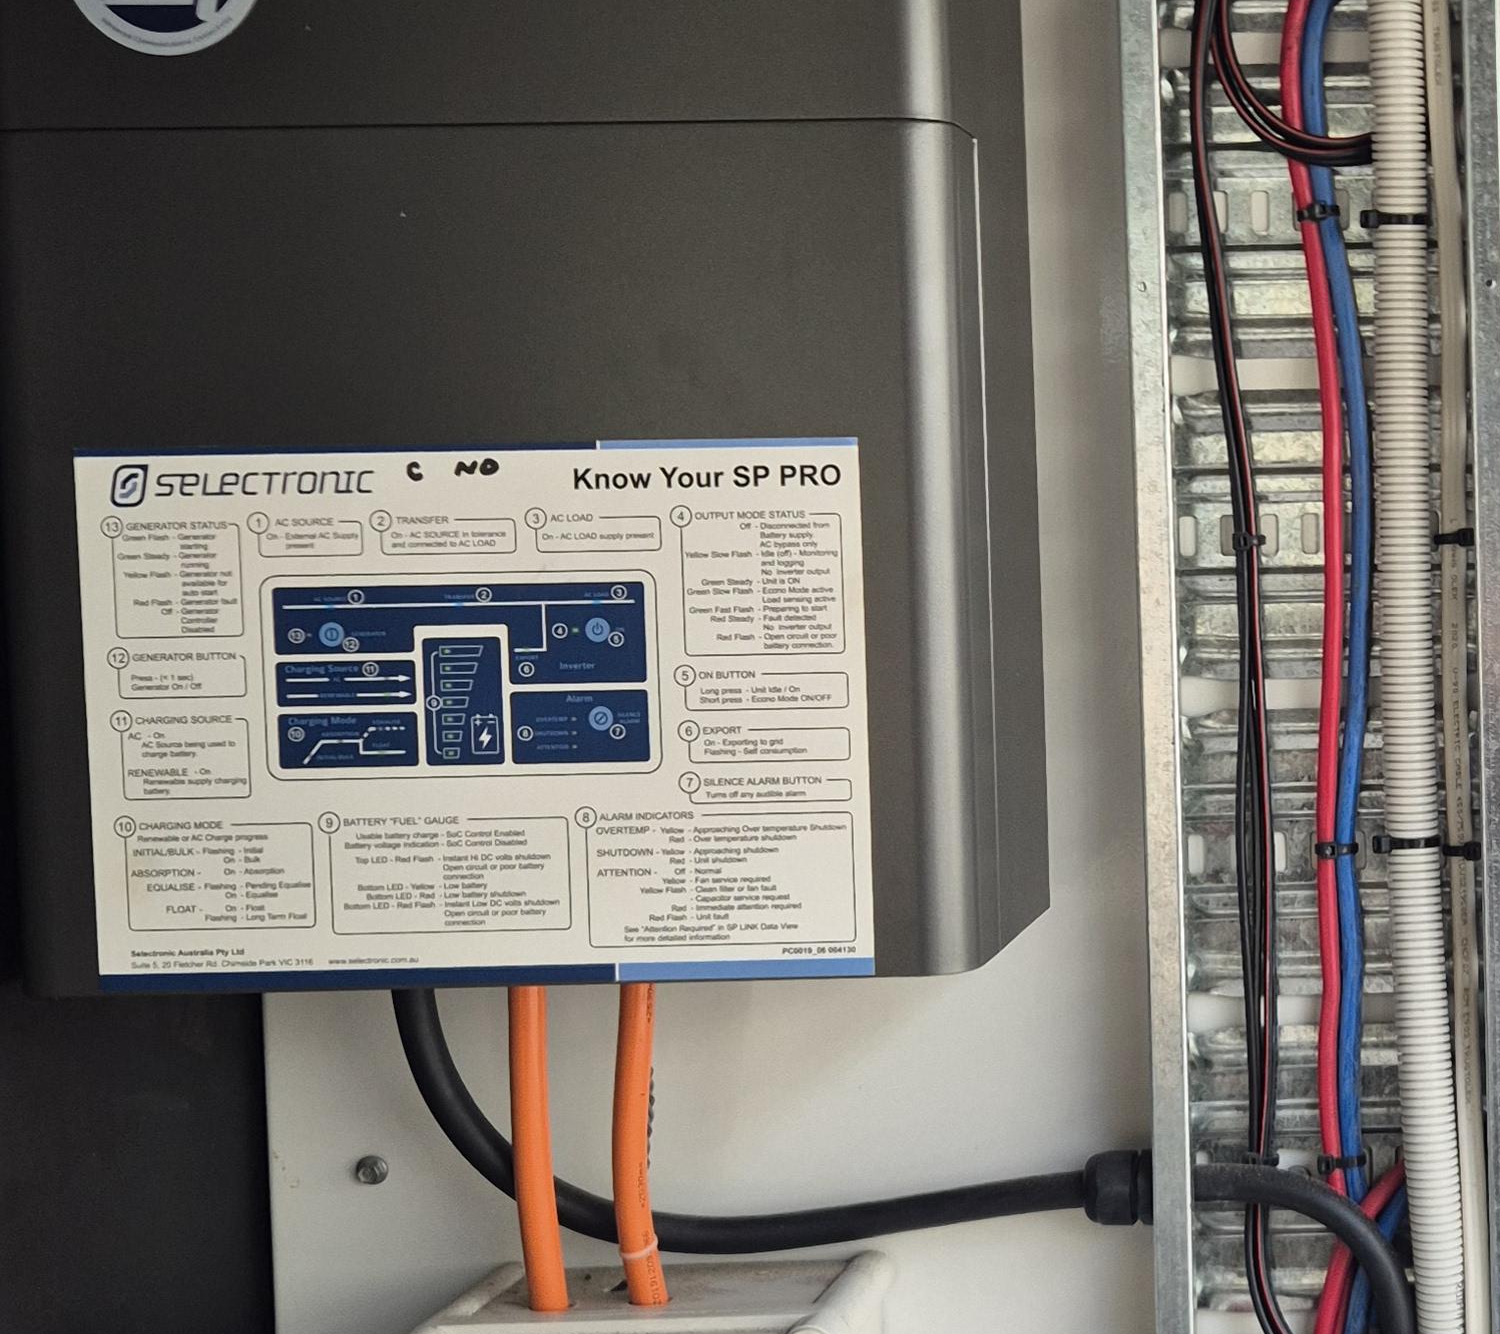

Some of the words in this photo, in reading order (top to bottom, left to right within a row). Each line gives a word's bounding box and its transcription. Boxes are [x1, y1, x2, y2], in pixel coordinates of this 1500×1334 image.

[574, 468, 651, 489] Know
[660, 466, 724, 488] Your
[733, 465, 770, 487] SP
[781, 464, 841, 486] PRO
[154, 470, 375, 497] SELECTRONIC
[377, 516, 384, 526] 2
[533, 514, 540, 524] 3
[567, 514, 593, 522] LOAD
[678, 512, 684, 521] 4
[695, 512, 734, 520] OUTPUT
[737, 511, 766, 519] MODE
[106, 522, 119, 532] 13
[126, 522, 188, 531] GENERATOR
[190, 521, 228, 530] STATUS
[292, 518, 334, 526] SOURCE
[112, 653, 125, 664] 12
[132, 653, 193, 661] GENERATOR
[197, 652, 236, 660] BUTTON
[682, 671, 689, 681] 5
[699, 671, 713, 679] ON
[716, 671, 755, 679] BUTTON
[116, 716, 127, 726] 11
[128, 732, 141, 740] AC
[685, 727, 692, 737] 6
[703, 726, 741, 734] EXPORT
[128, 768, 188, 777] RENEWABLE
[686, 778, 693, 787] 7
[703, 778, 744, 786] SILENCE
[747, 777, 780, 785] ALARM
[783, 776, 822, 784] BUTTON
[325, 818, 333, 828] 9
[344, 818, 387, 827] BATTERY
[424, 817, 459, 825] GAUGE
[583, 813, 589, 823] 8
[600, 812, 633, 821] ALARM
[636, 812, 694, 820] INDICATORS
[119, 822, 132, 831] 10
[139, 822, 191, 830] CHARGING
[194, 821, 223, 829] MODE
[596, 826, 650, 835] OVERTEMP
[133, 848, 194, 857] INITIAL/BULK
[597, 848, 653, 857] SHUTDOWN
[131, 869, 195, 877] ABSORPTION
[597, 868, 651, 877] ATTENTION
[147, 883, 195, 891] EQUALISE
[166, 905, 196, 914] FLOAT
[178, 949, 214, 957] Australia
[216, 949, 229, 957] Pty
[231, 948, 244, 956] Ltd
